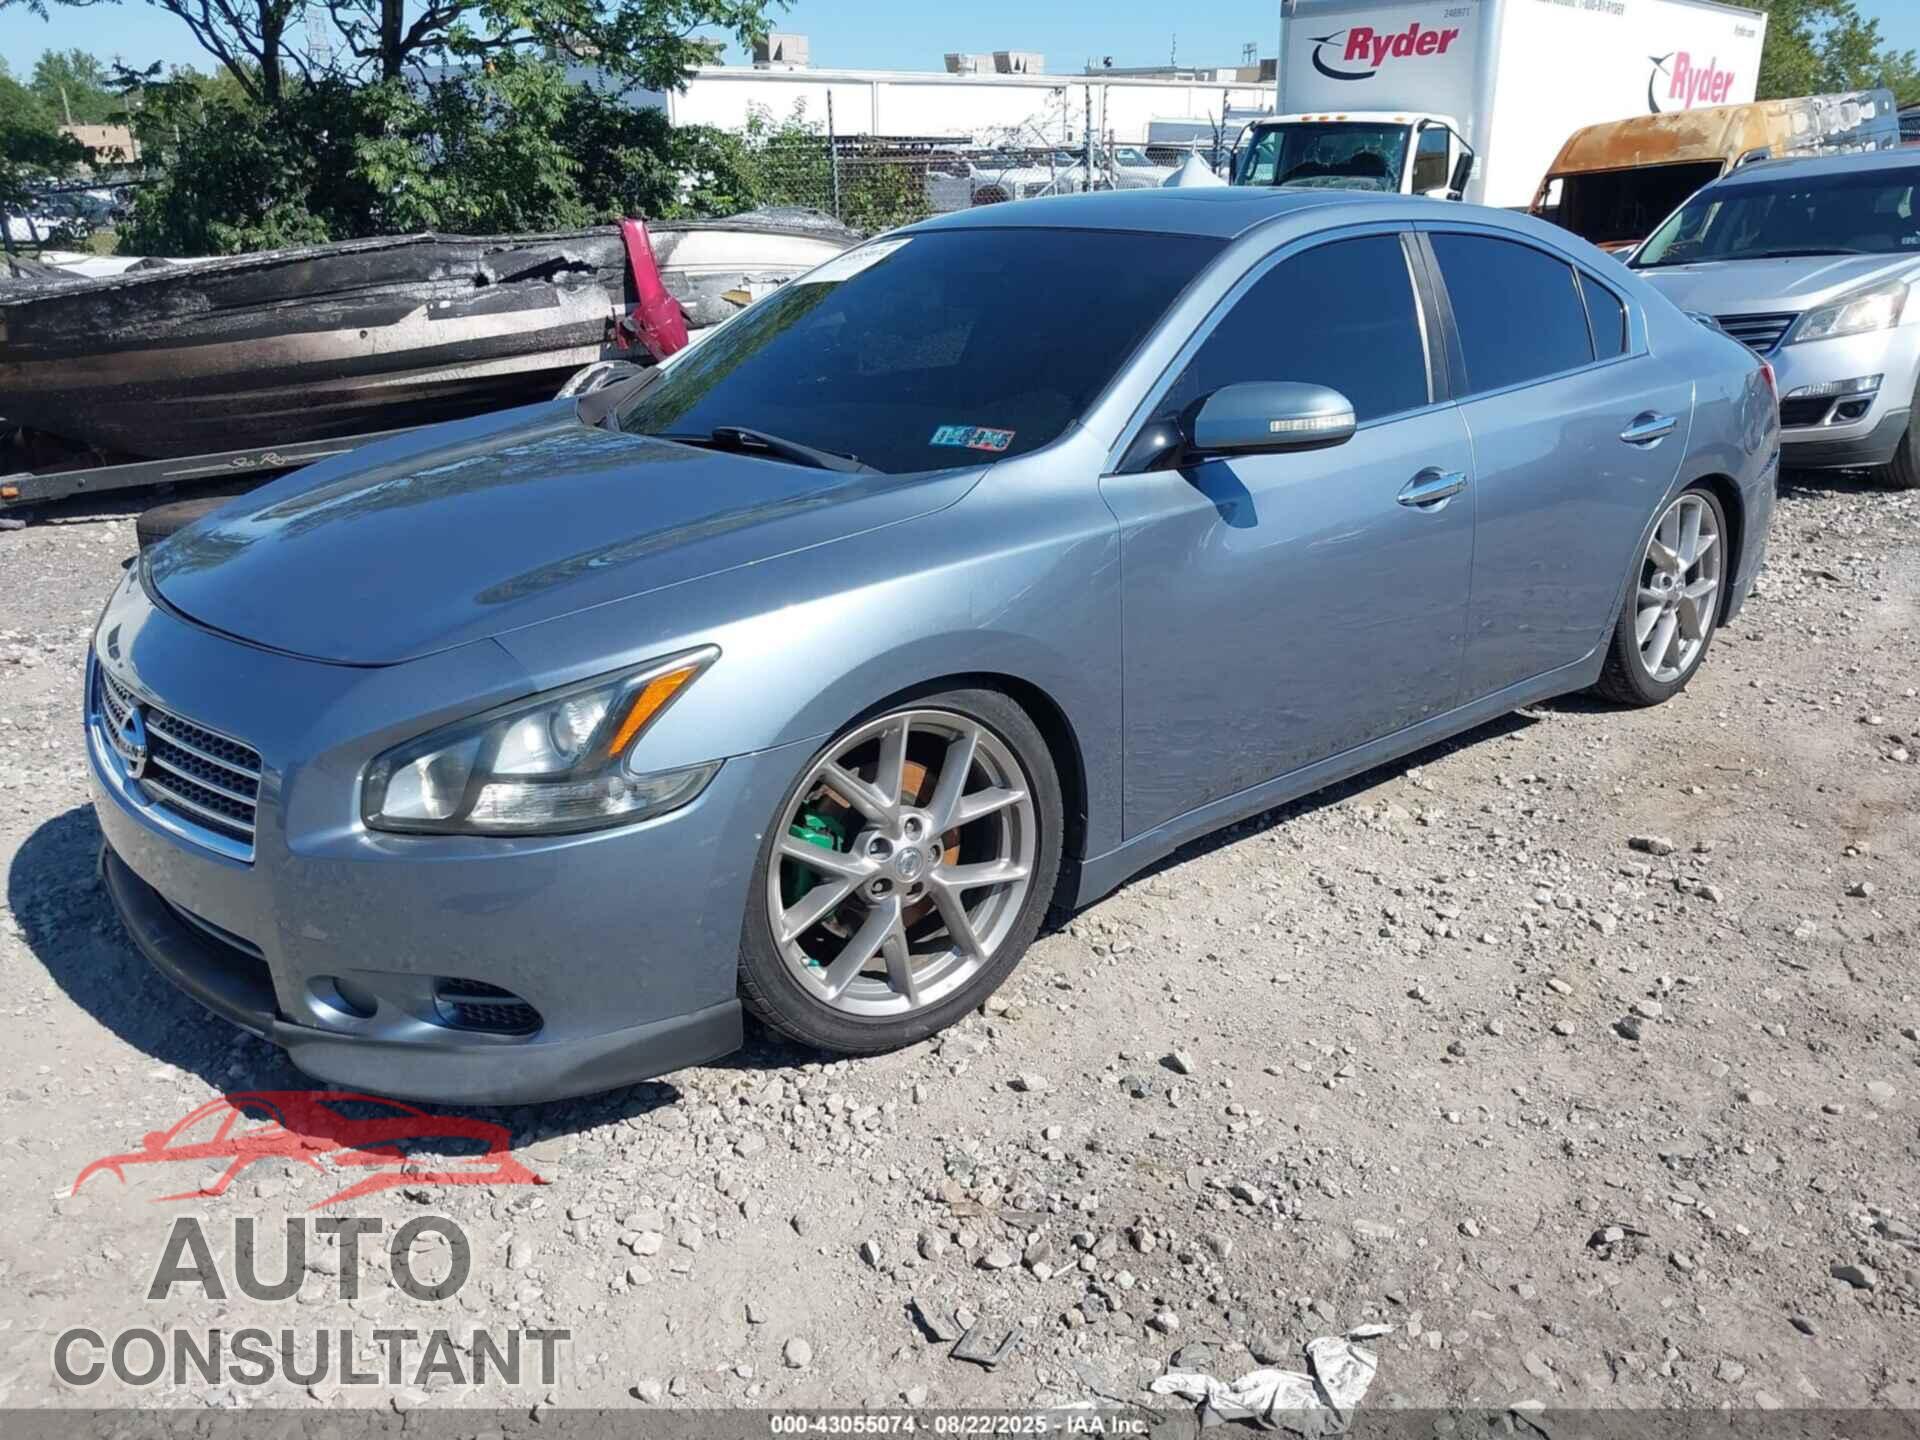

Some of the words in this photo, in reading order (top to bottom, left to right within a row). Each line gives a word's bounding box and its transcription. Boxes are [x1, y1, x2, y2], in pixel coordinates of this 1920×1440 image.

[1343, 22, 1459, 67] Ryder
[1668, 51, 1735, 110] Ryder
[260, 452, 289, 466] Ray
